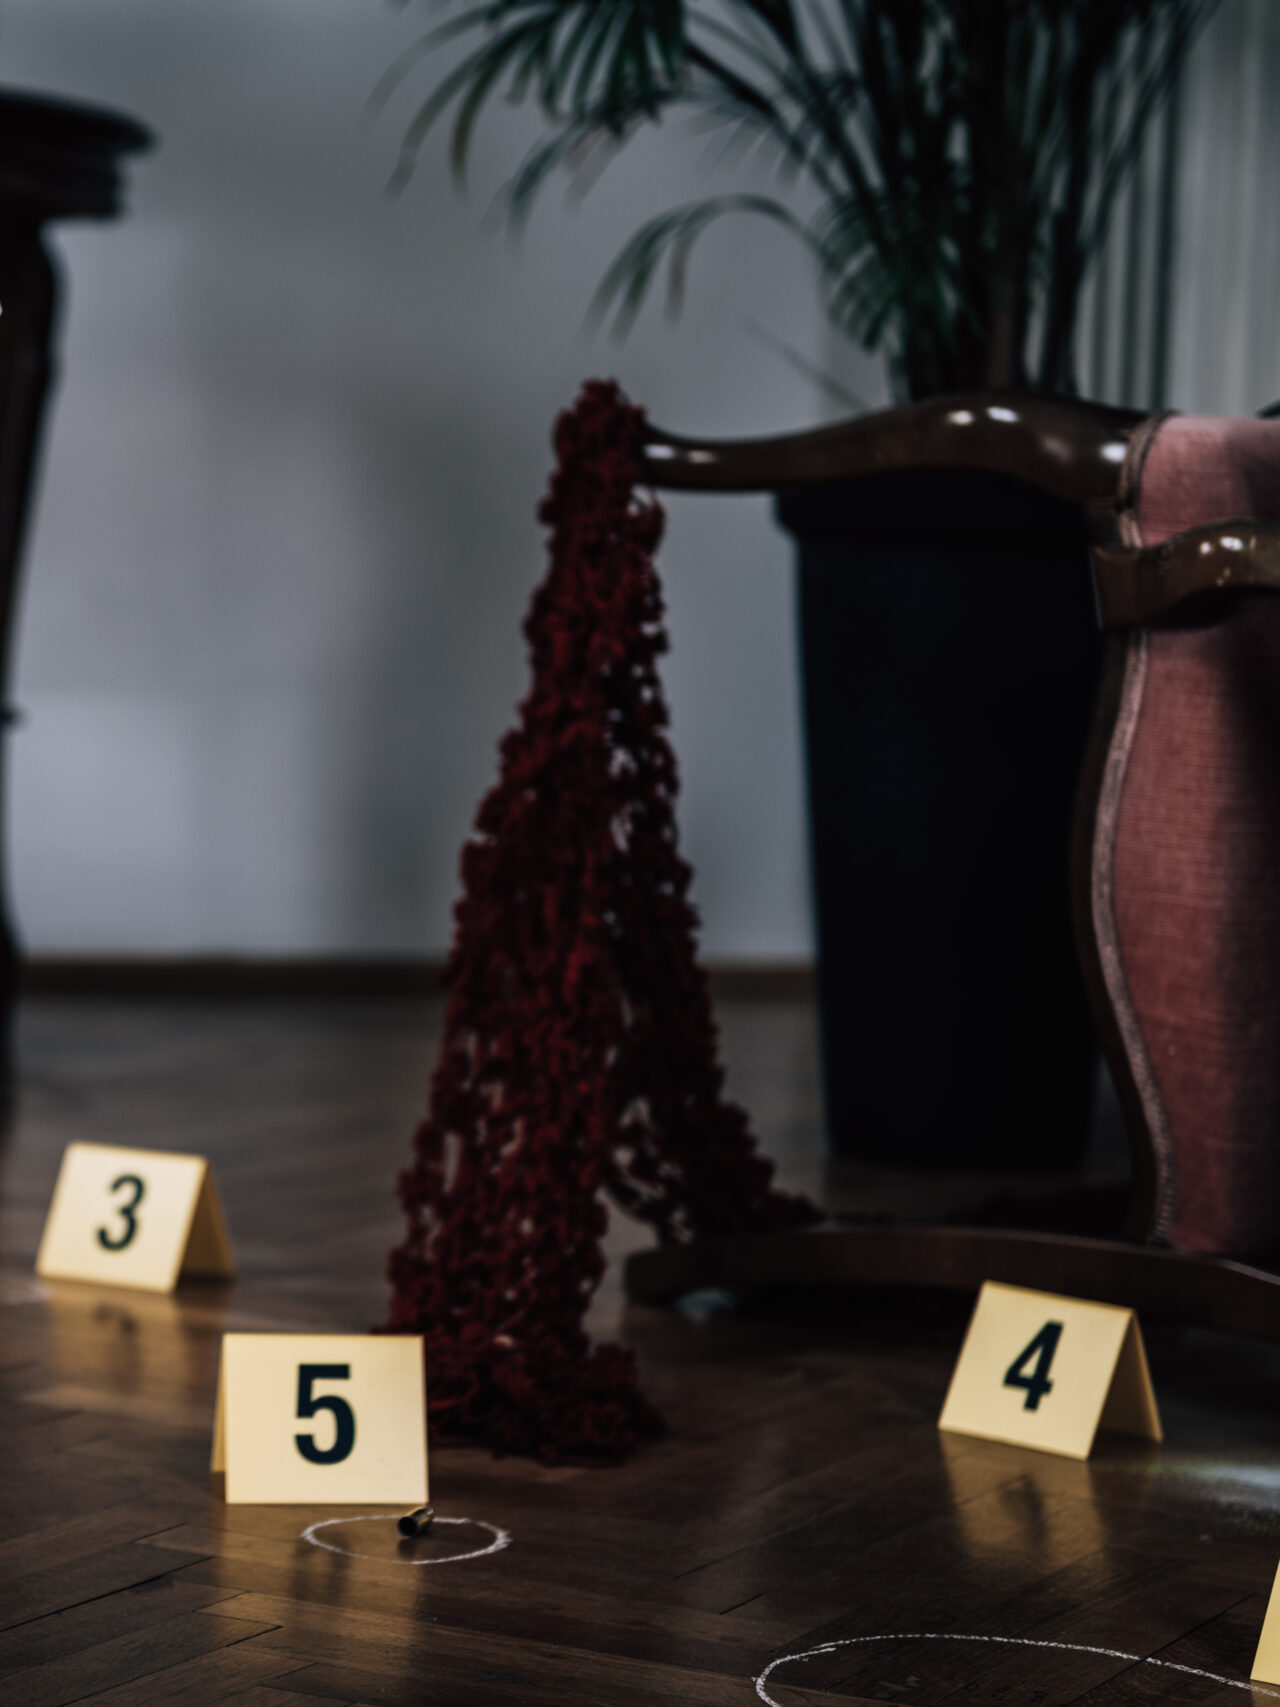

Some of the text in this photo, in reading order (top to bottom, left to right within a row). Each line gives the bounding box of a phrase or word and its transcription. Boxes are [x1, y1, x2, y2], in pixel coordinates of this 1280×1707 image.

[95, 1173, 146, 1253] 3
[1003, 1320, 1064, 1412] 4
[294, 1363, 356, 1466] 5
